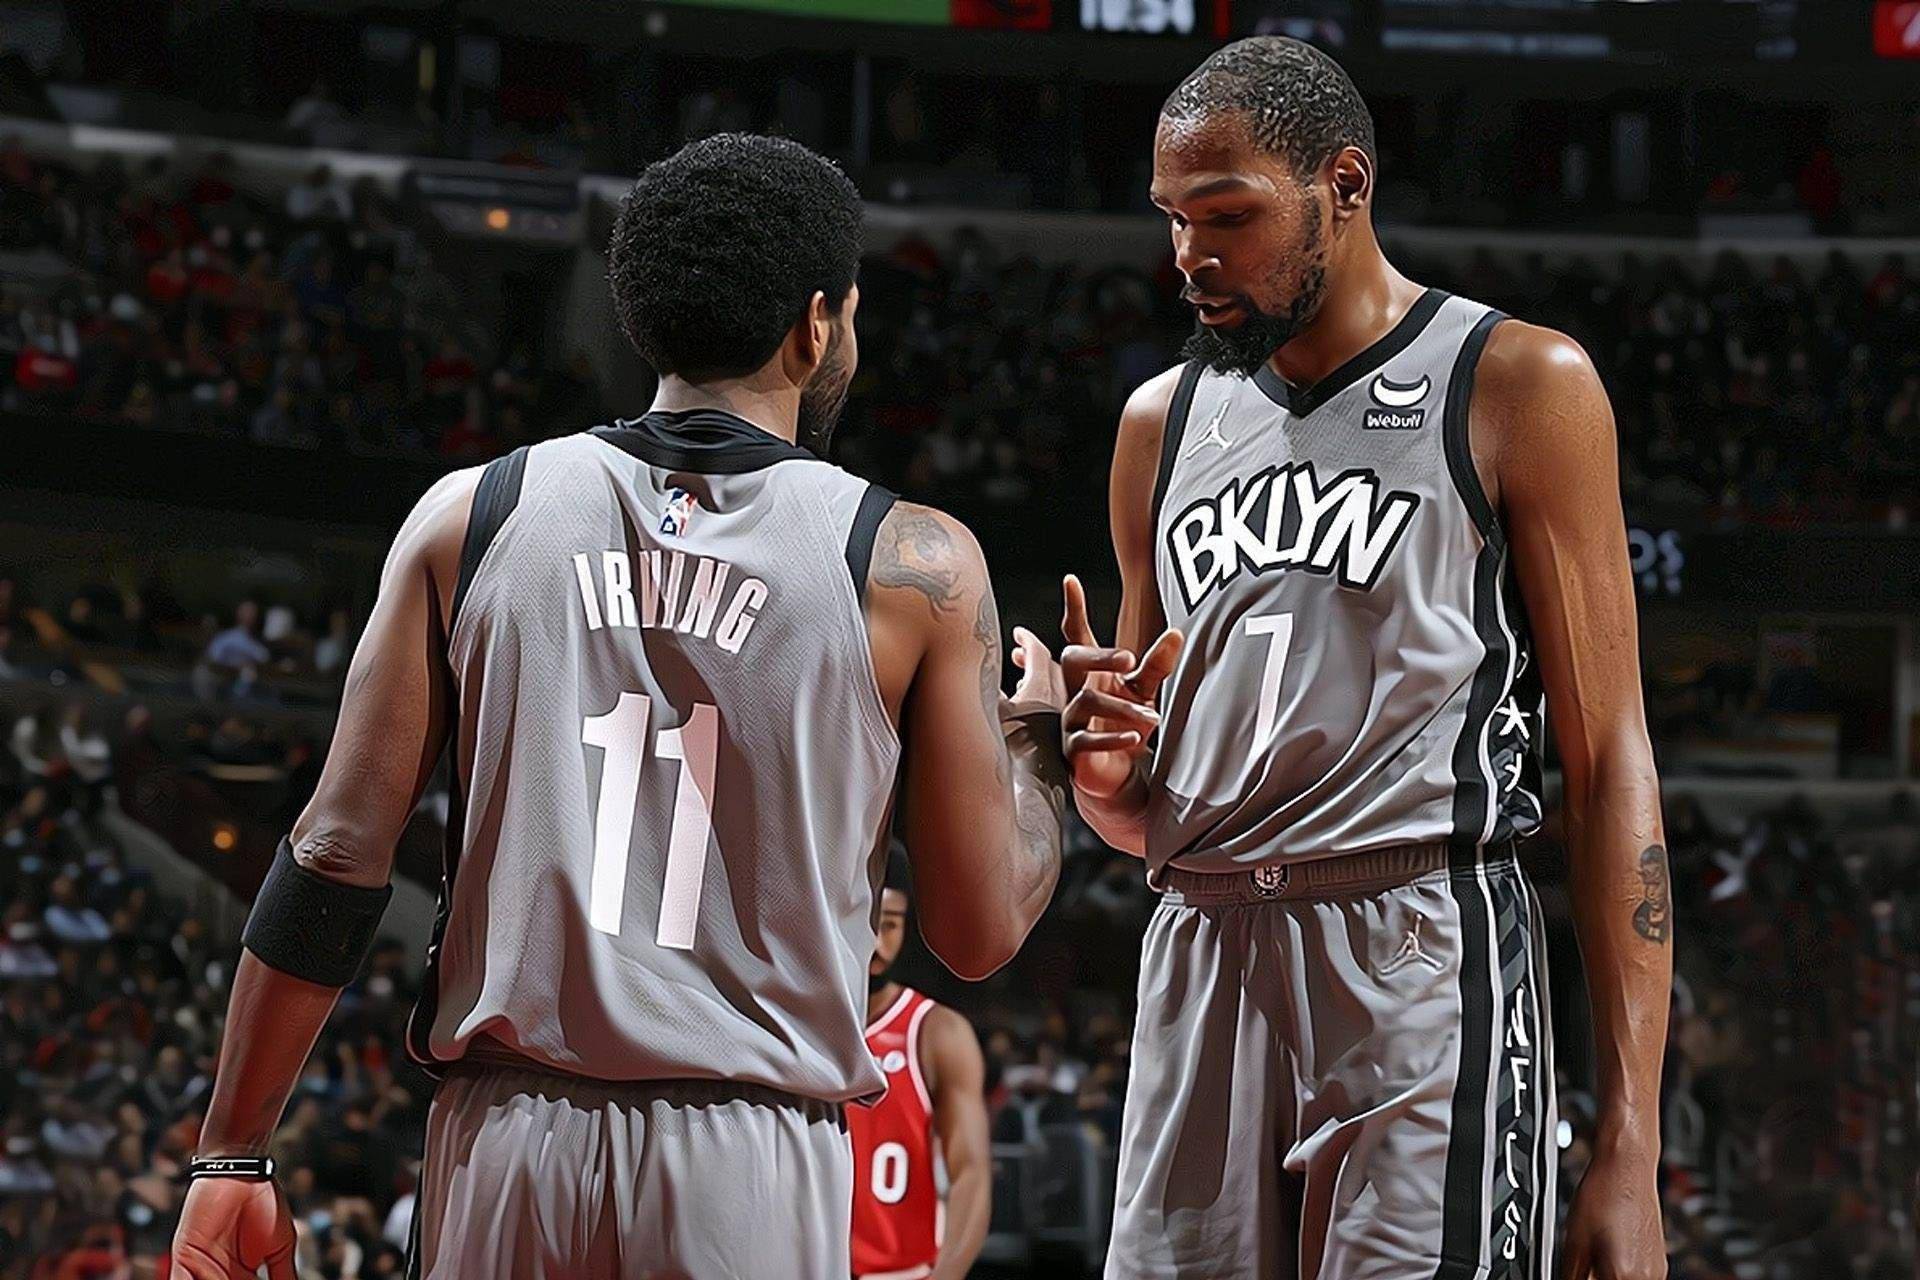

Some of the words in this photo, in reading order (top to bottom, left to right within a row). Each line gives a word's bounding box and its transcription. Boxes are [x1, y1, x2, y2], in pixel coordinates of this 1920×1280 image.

[572, 549, 769, 655] IRVING
[1168, 461, 1420, 615] BKLYN
[1245, 612, 1294, 763] 7
[581, 691, 719, 950] 11
[871, 1141, 909, 1204] 0
